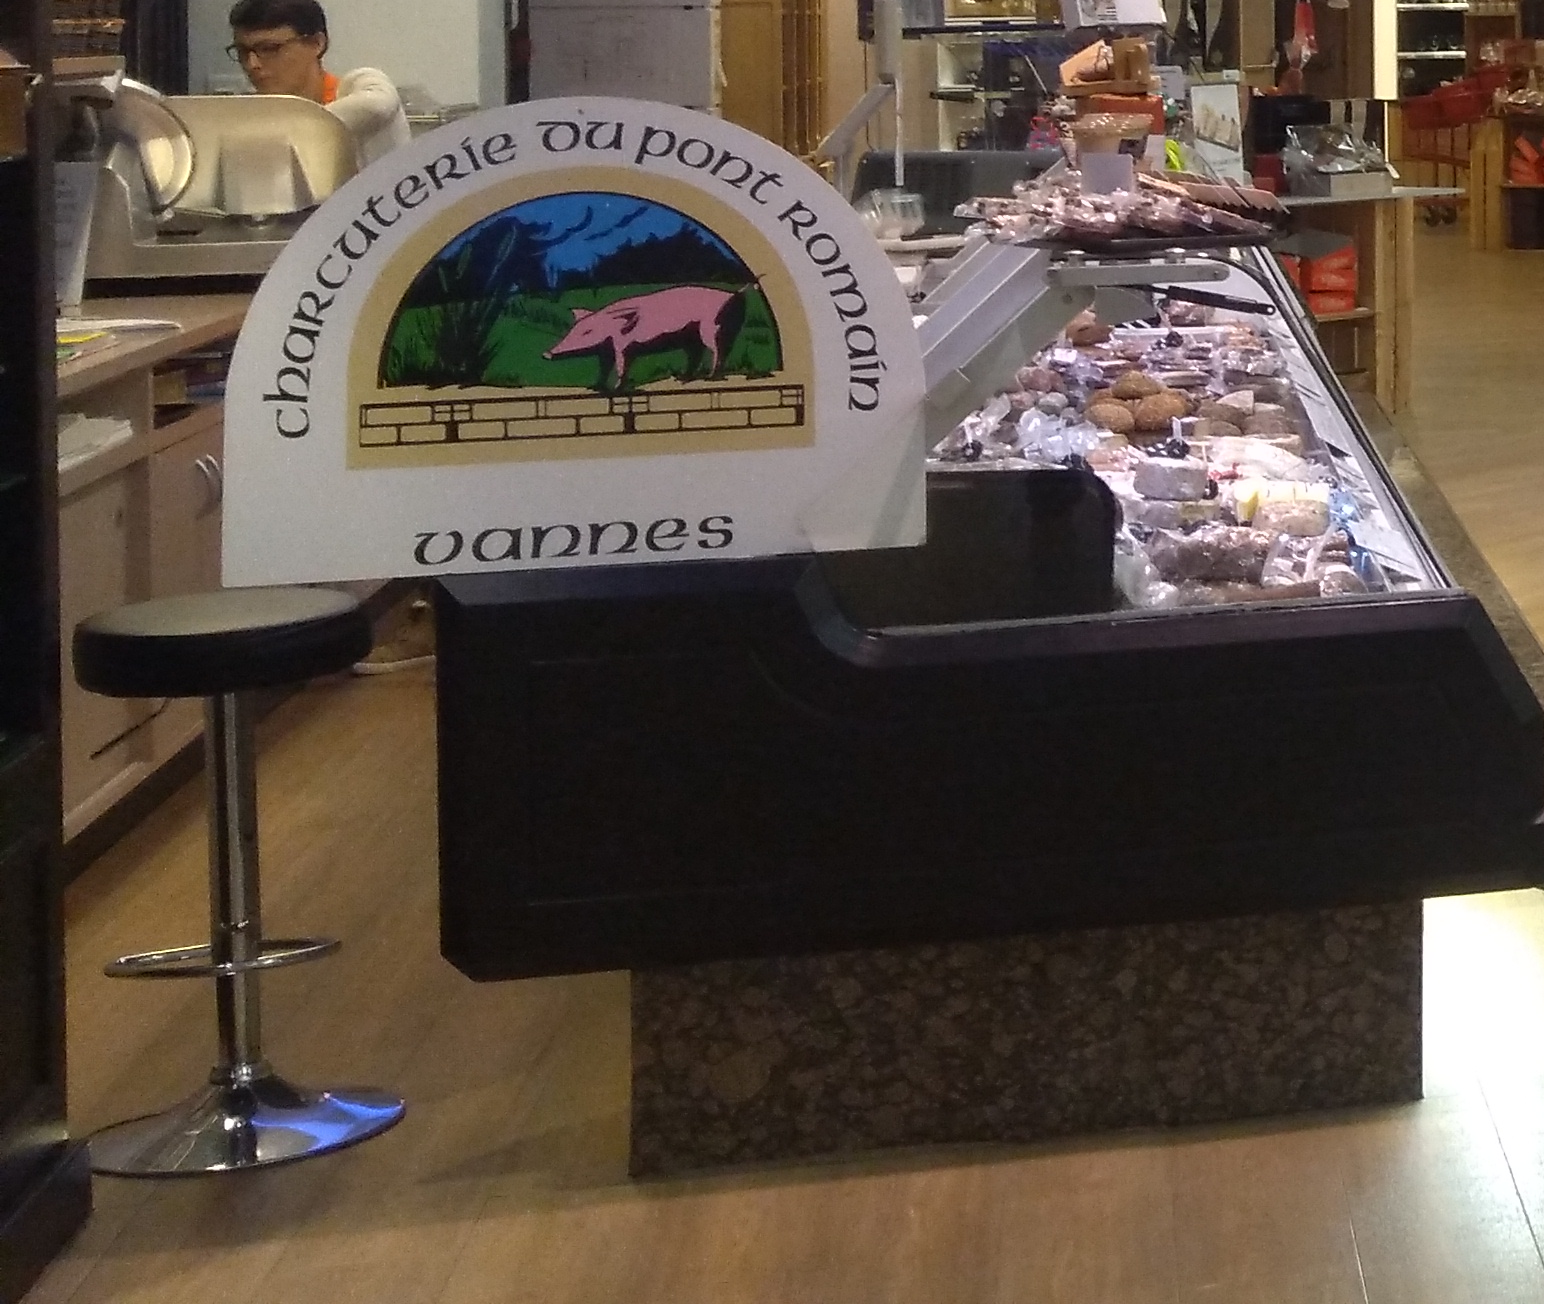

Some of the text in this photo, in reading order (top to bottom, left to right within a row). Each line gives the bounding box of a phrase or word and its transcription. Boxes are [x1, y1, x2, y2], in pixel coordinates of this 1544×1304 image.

[535, 118, 625, 154] du
[634, 125, 790, 207] pont
[776, 196, 882, 414] romain
[412, 511, 736, 568] vannes
